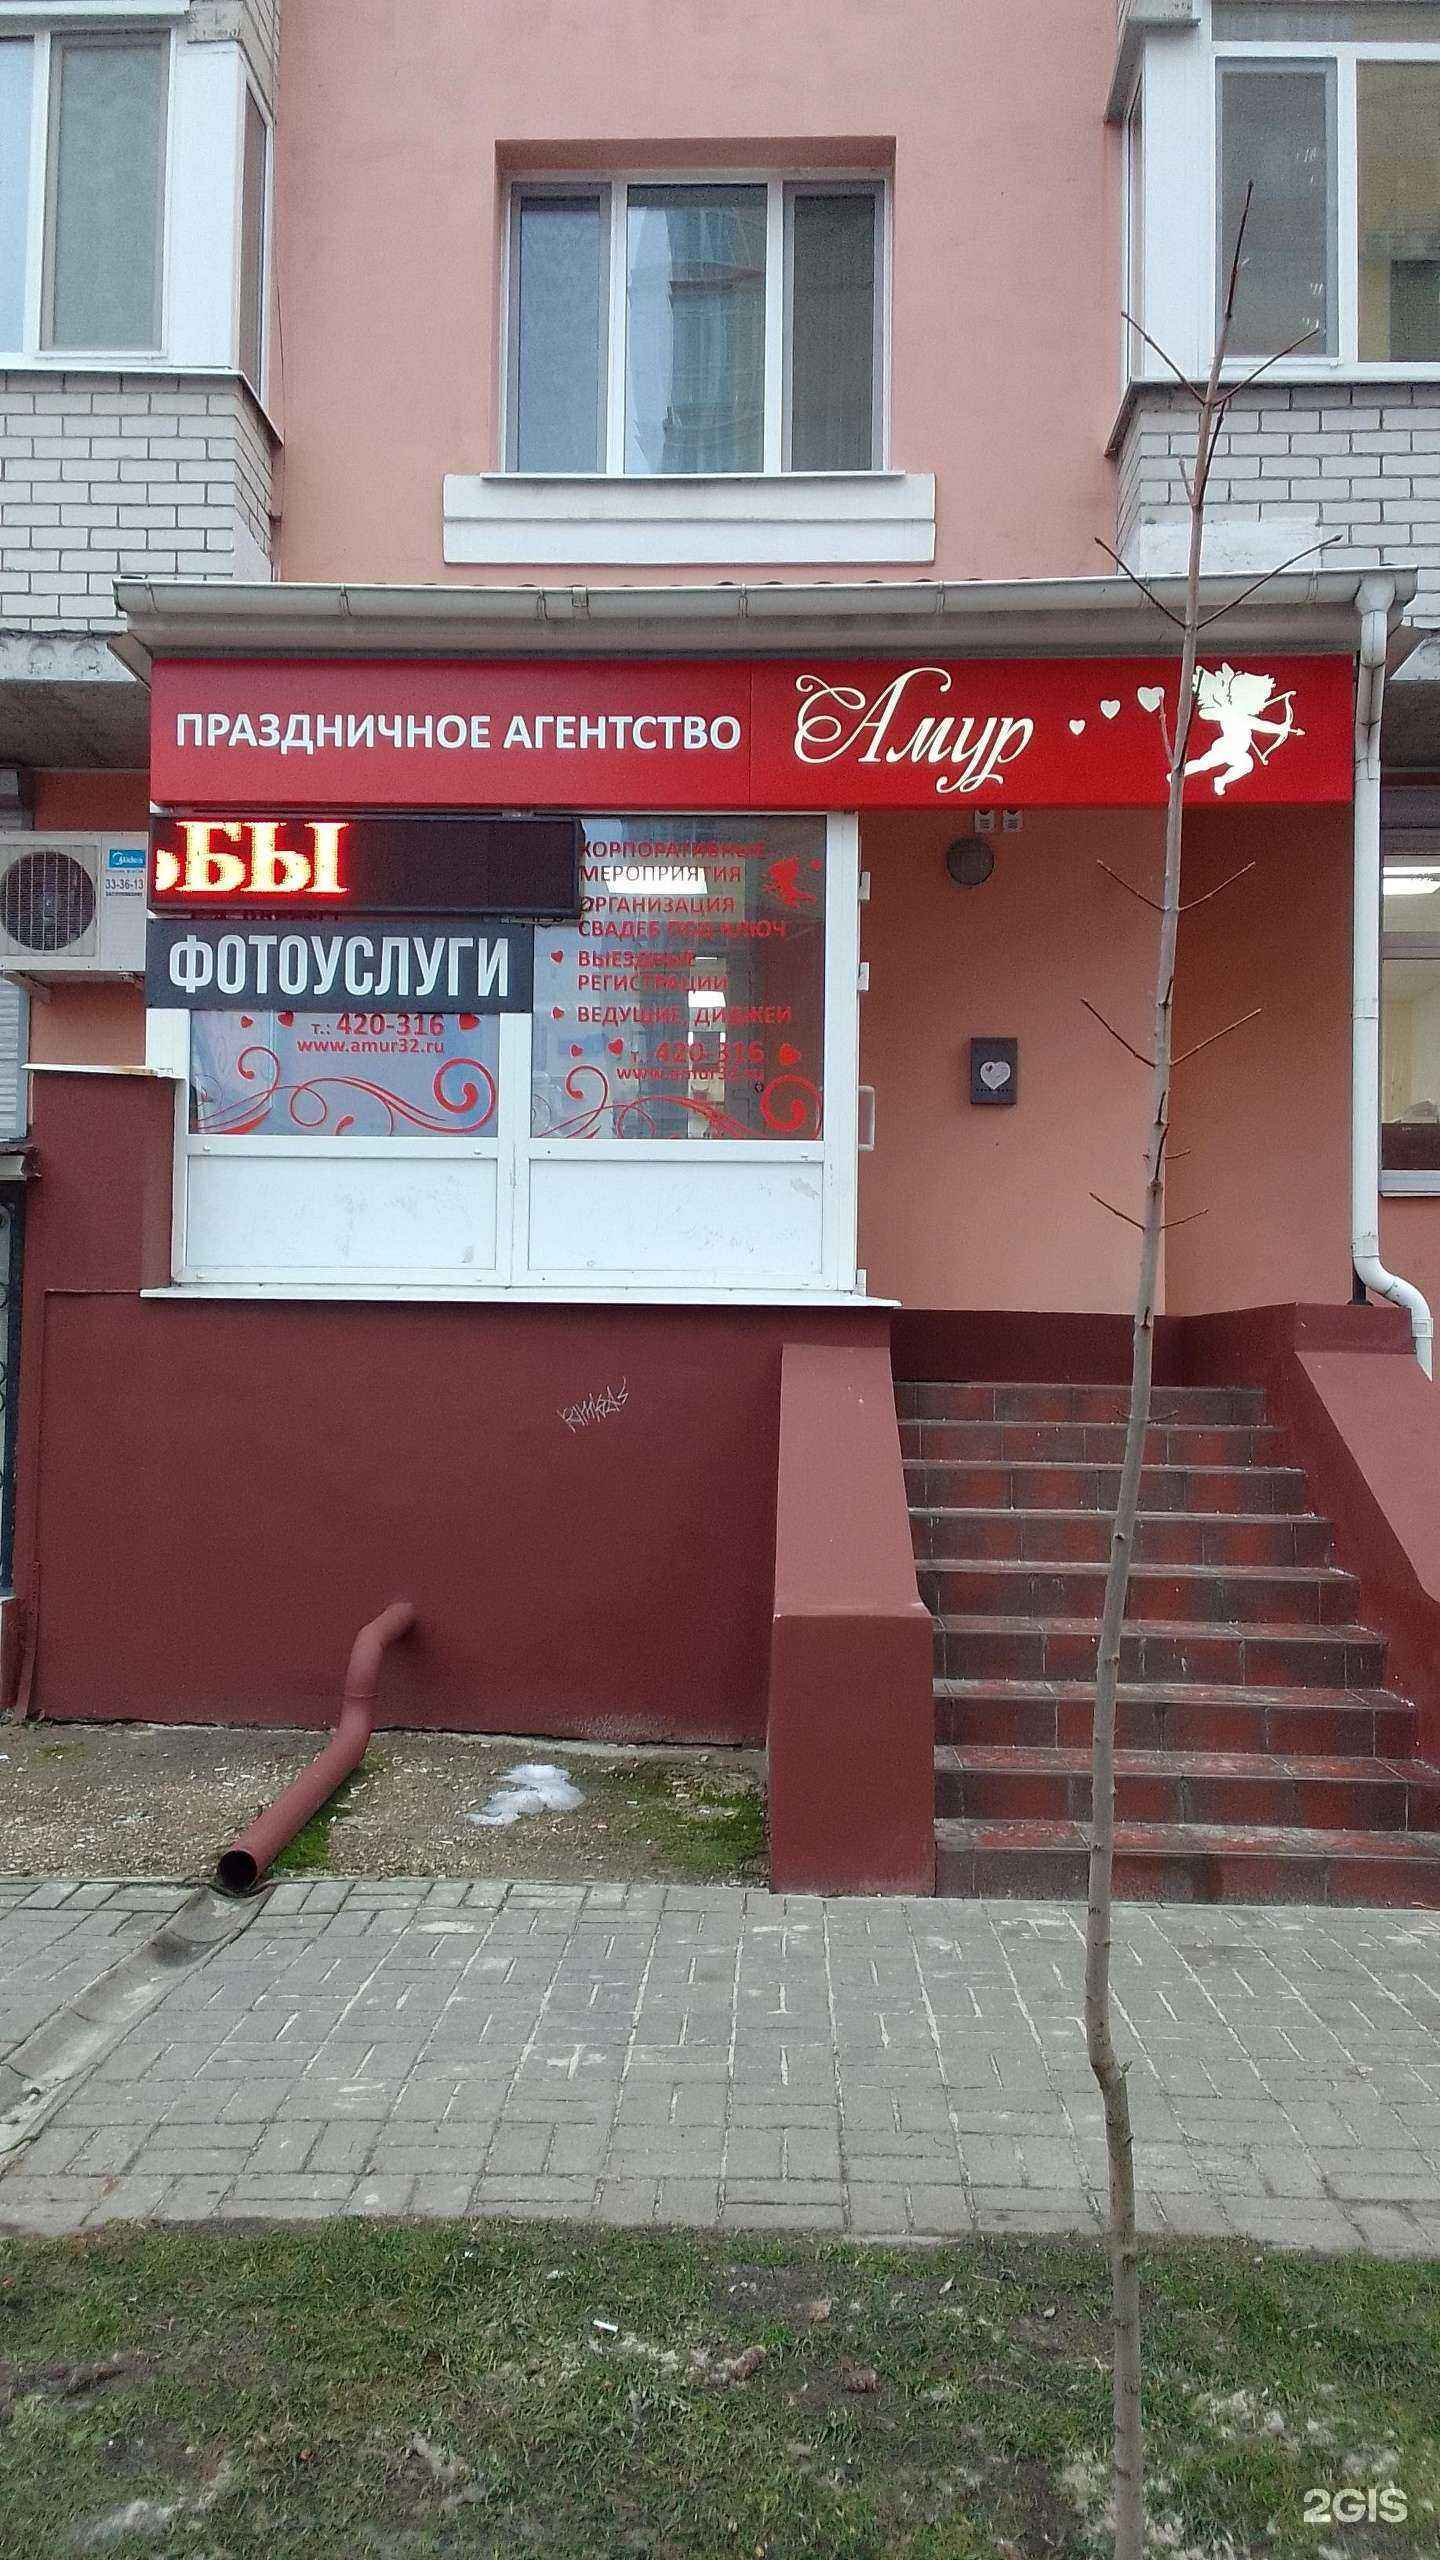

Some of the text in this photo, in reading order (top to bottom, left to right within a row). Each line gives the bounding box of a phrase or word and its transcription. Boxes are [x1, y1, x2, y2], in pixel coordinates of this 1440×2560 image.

[175, 712, 743, 756] ПРАЗДНИЧНОЕ АГЕНТСТВО
[794, 666, 1036, 794] Амур
[579, 865, 742, 882] МЕРОПРИЯТИЯ
[105, 878, 144, 890] 33-36-13
[580, 896, 737, 915] ОРГАНИЗАЦИЯ
[578, 919, 661, 940] СВАДЕБ
[169, 934, 510, 997] ФОТОУСЛУГИ
[578, 975, 729, 993] РЕГИСТРАЦИИ
[336, 1011, 445, 1036] 420-316
[297, 1038, 445, 1054] www.amur32.ru
